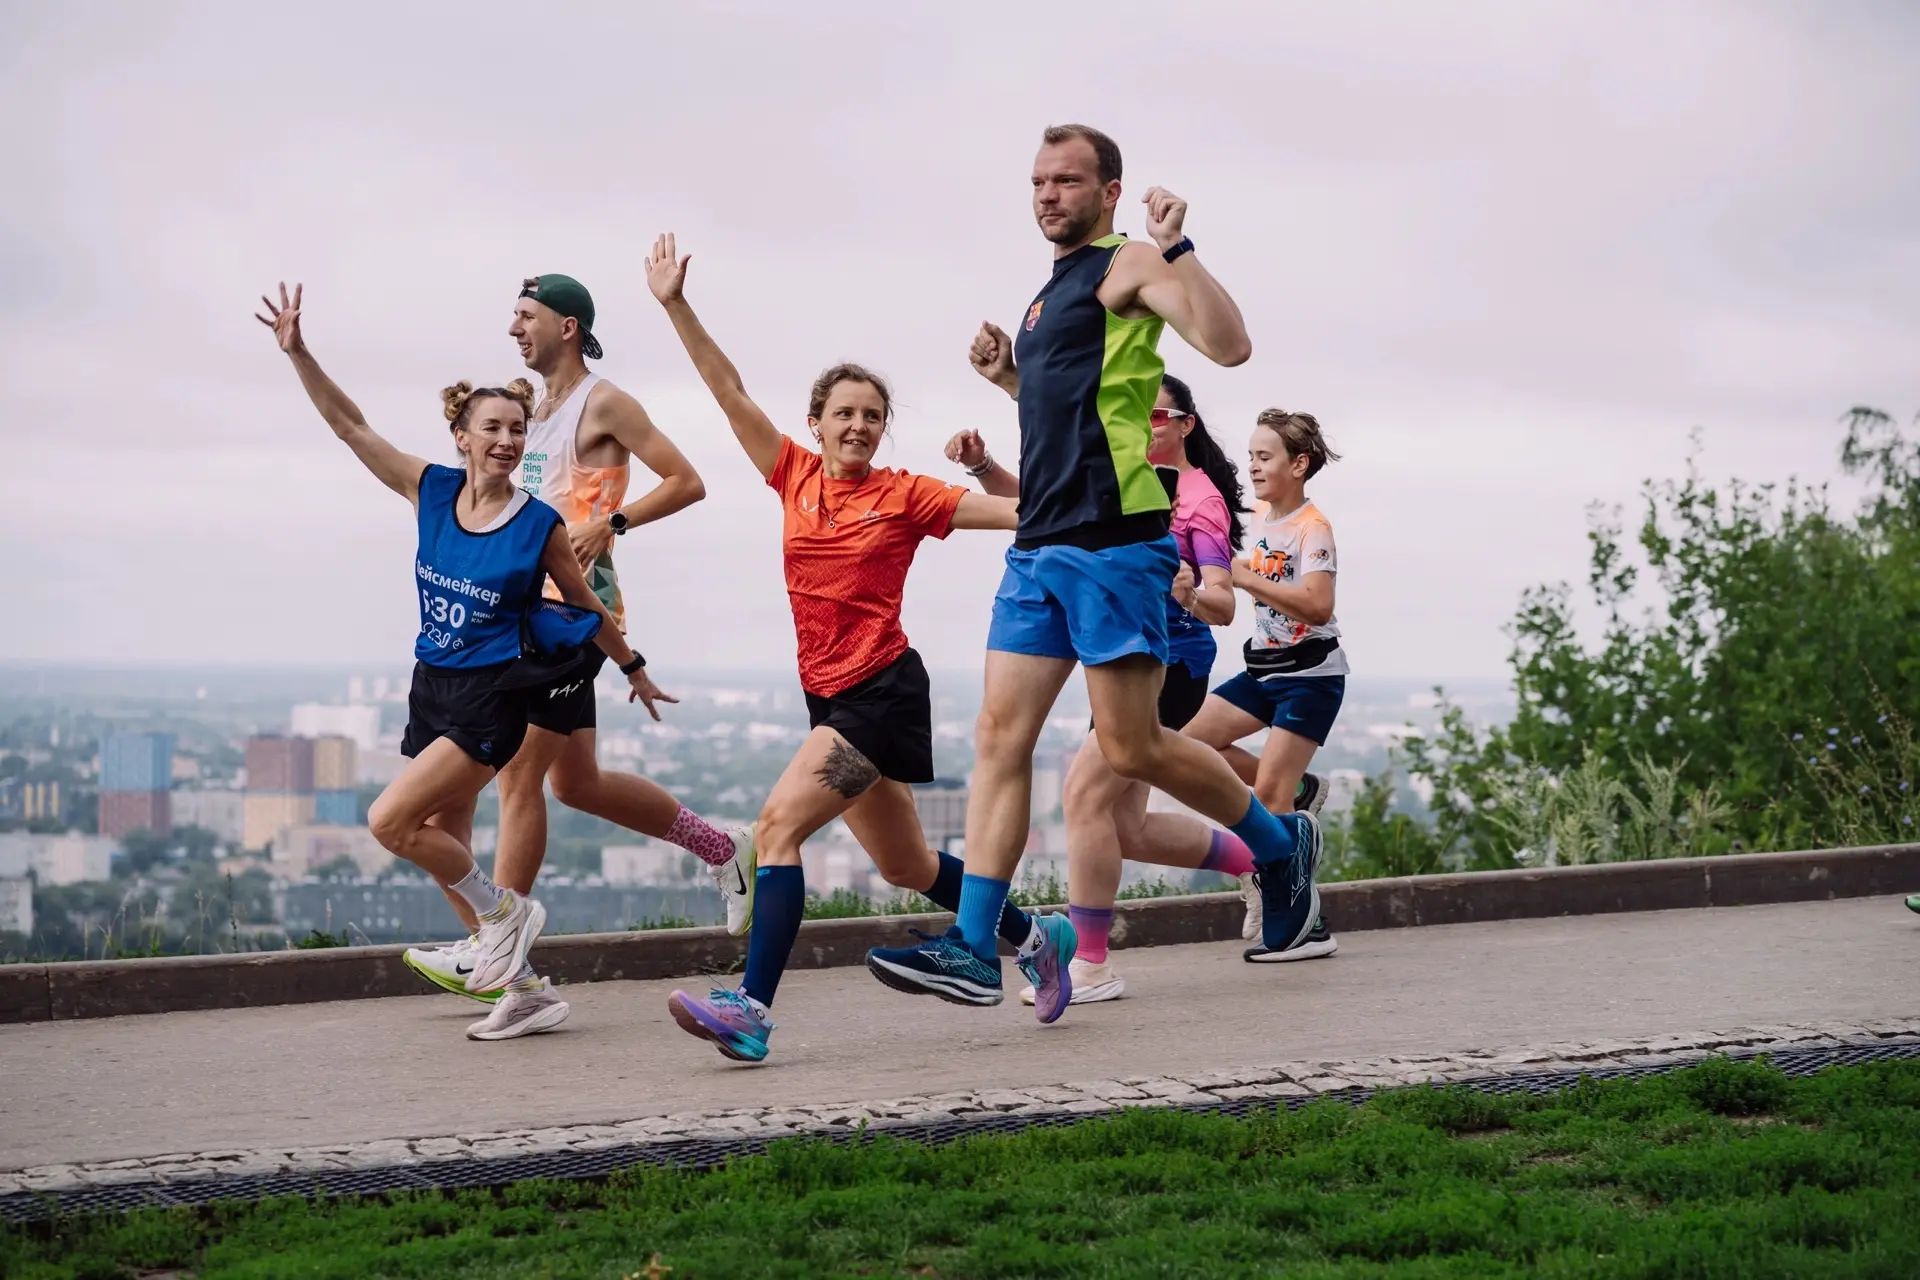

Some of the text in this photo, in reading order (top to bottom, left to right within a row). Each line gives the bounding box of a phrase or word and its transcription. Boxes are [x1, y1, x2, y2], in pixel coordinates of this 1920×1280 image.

[522, 452, 548, 461] olden
[523, 462, 542, 475] Ring
[522, 474, 542, 484] Ultra
